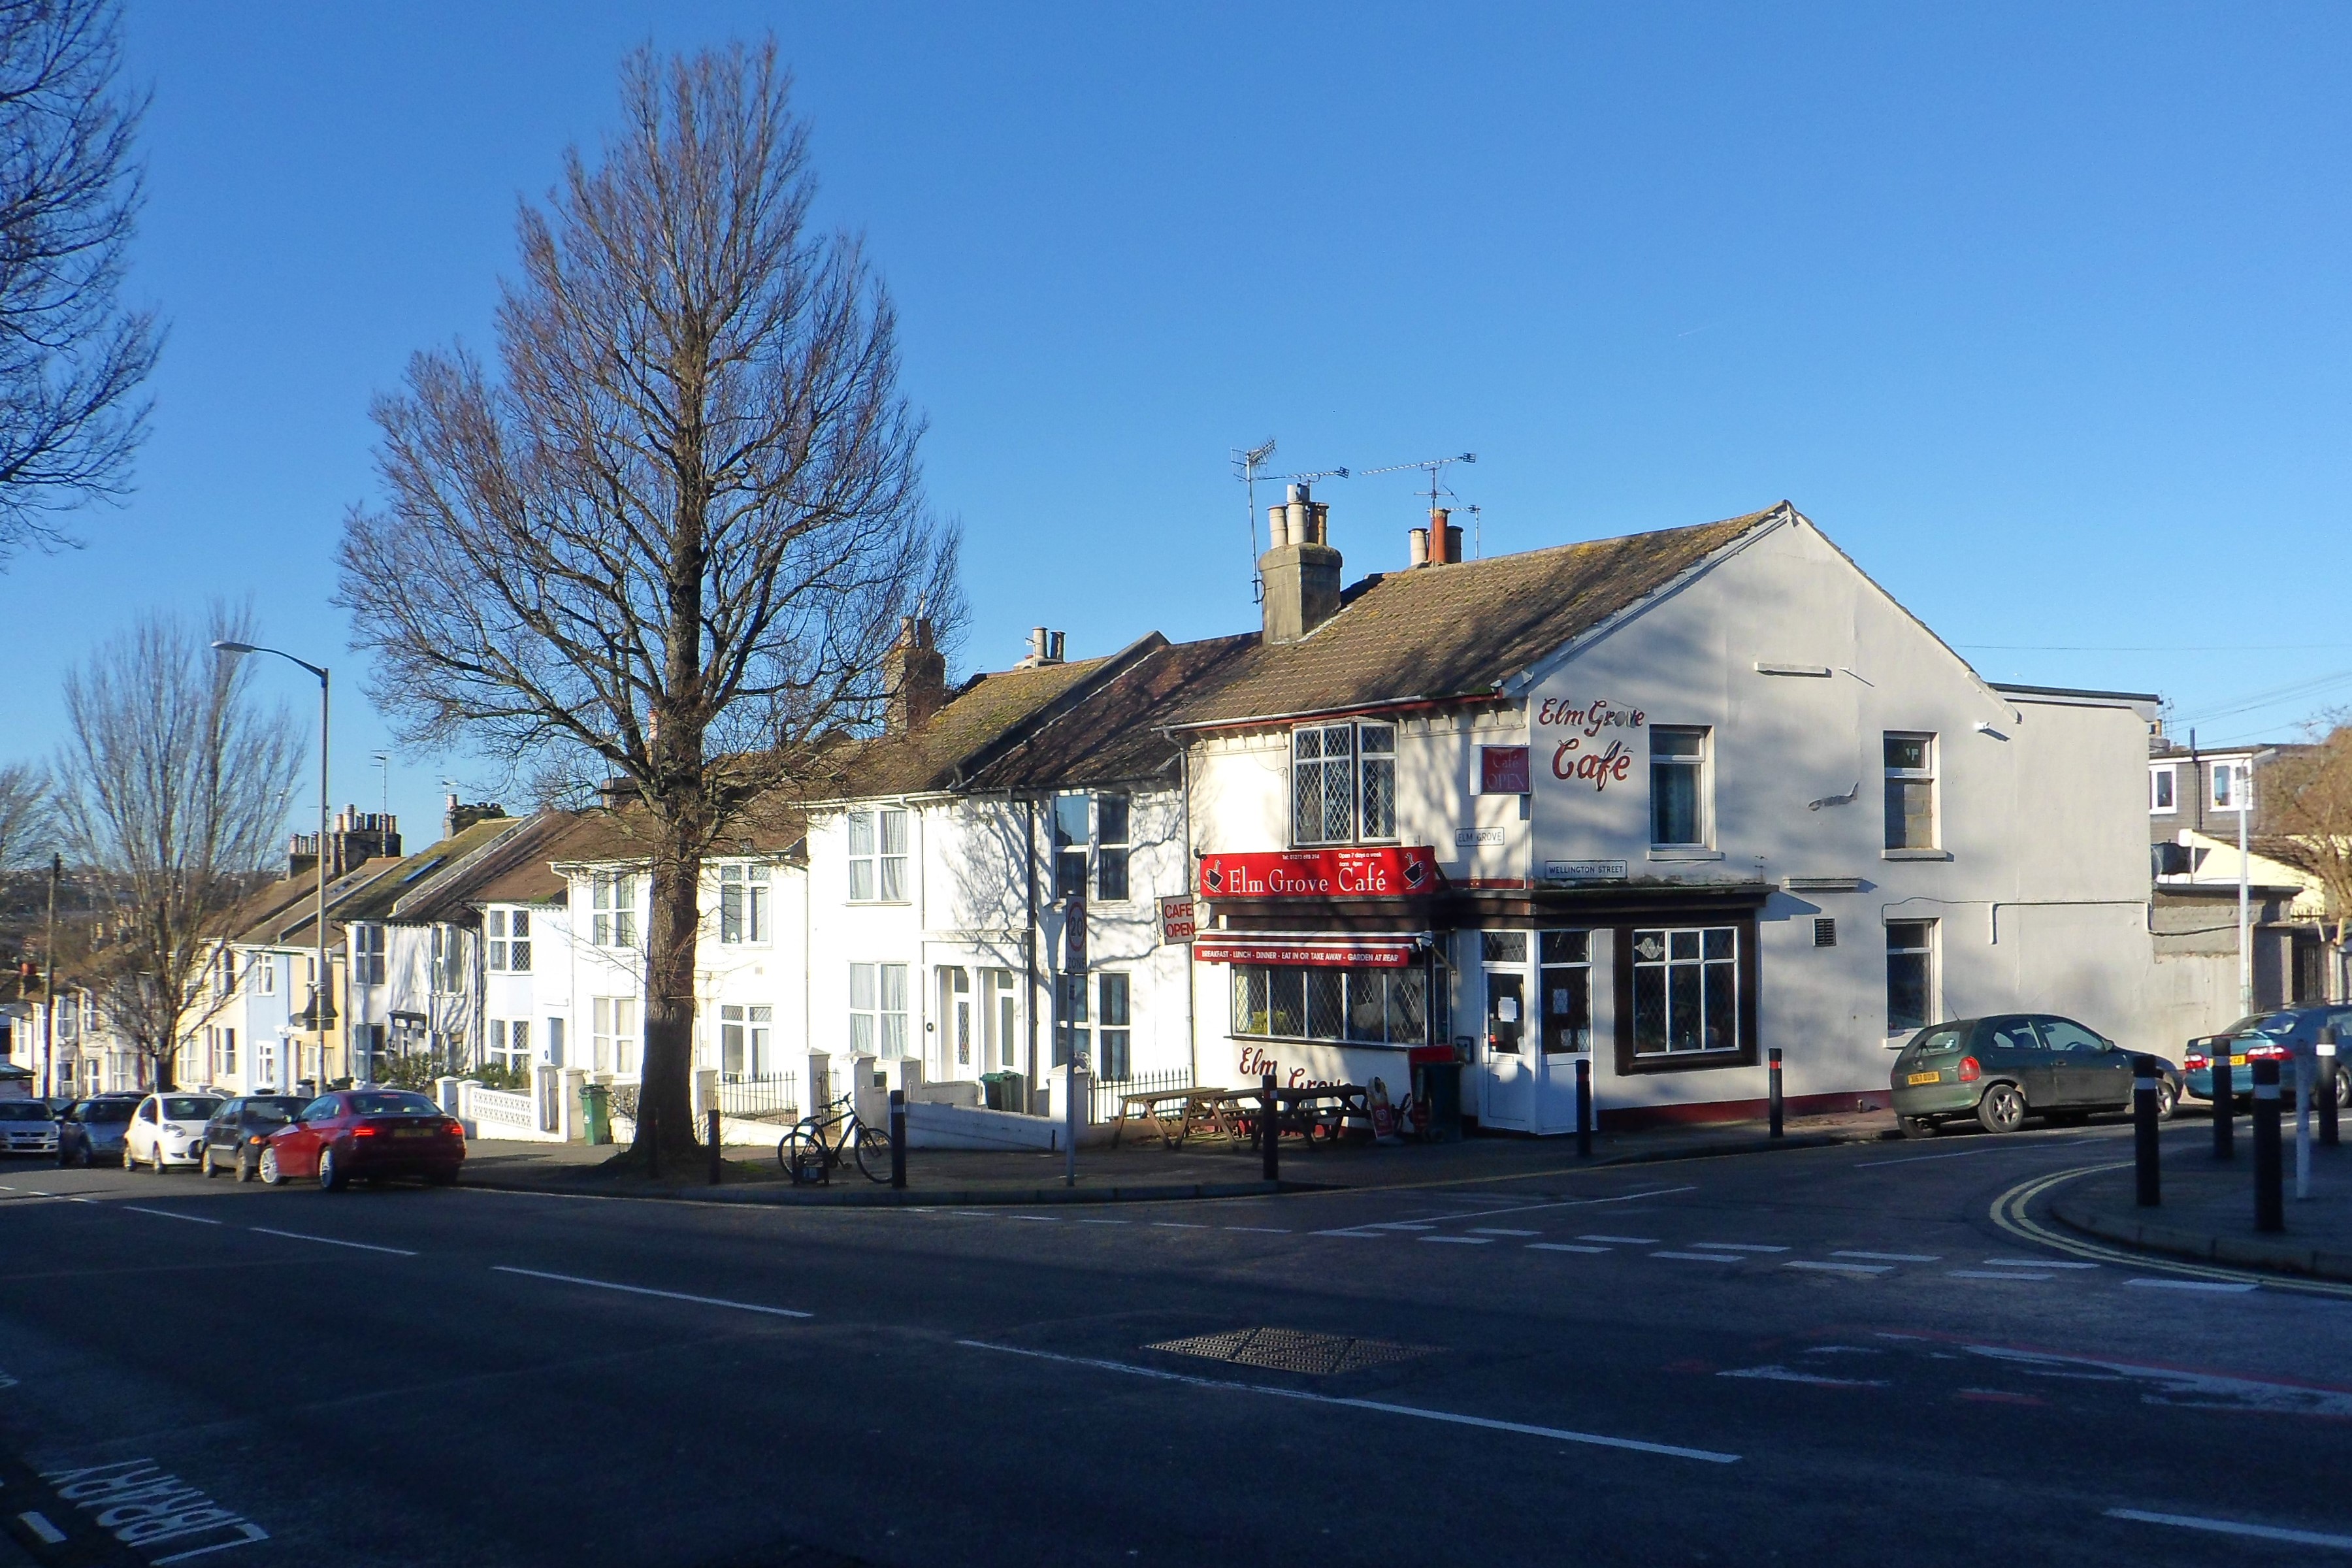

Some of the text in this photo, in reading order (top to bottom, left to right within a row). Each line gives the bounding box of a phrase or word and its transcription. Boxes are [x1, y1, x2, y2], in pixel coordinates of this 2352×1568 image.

[1538, 698, 1645, 737] Elm Grove
[1486, 774, 1524, 789] OPEN
[1458, 832, 1502, 842] ELM GROVE
[1228, 862, 1386, 894] Elm Grove Café
[1164, 903, 1193, 919] CAFE
[1071, 916, 1083, 936] 20
[1166, 921, 1196, 938] OPEN
[1068, 957, 1085, 970] ZONE
[1239, 1047, 1278, 1075] Elm
[38, 1458, 271, 1567] LIBRARY
